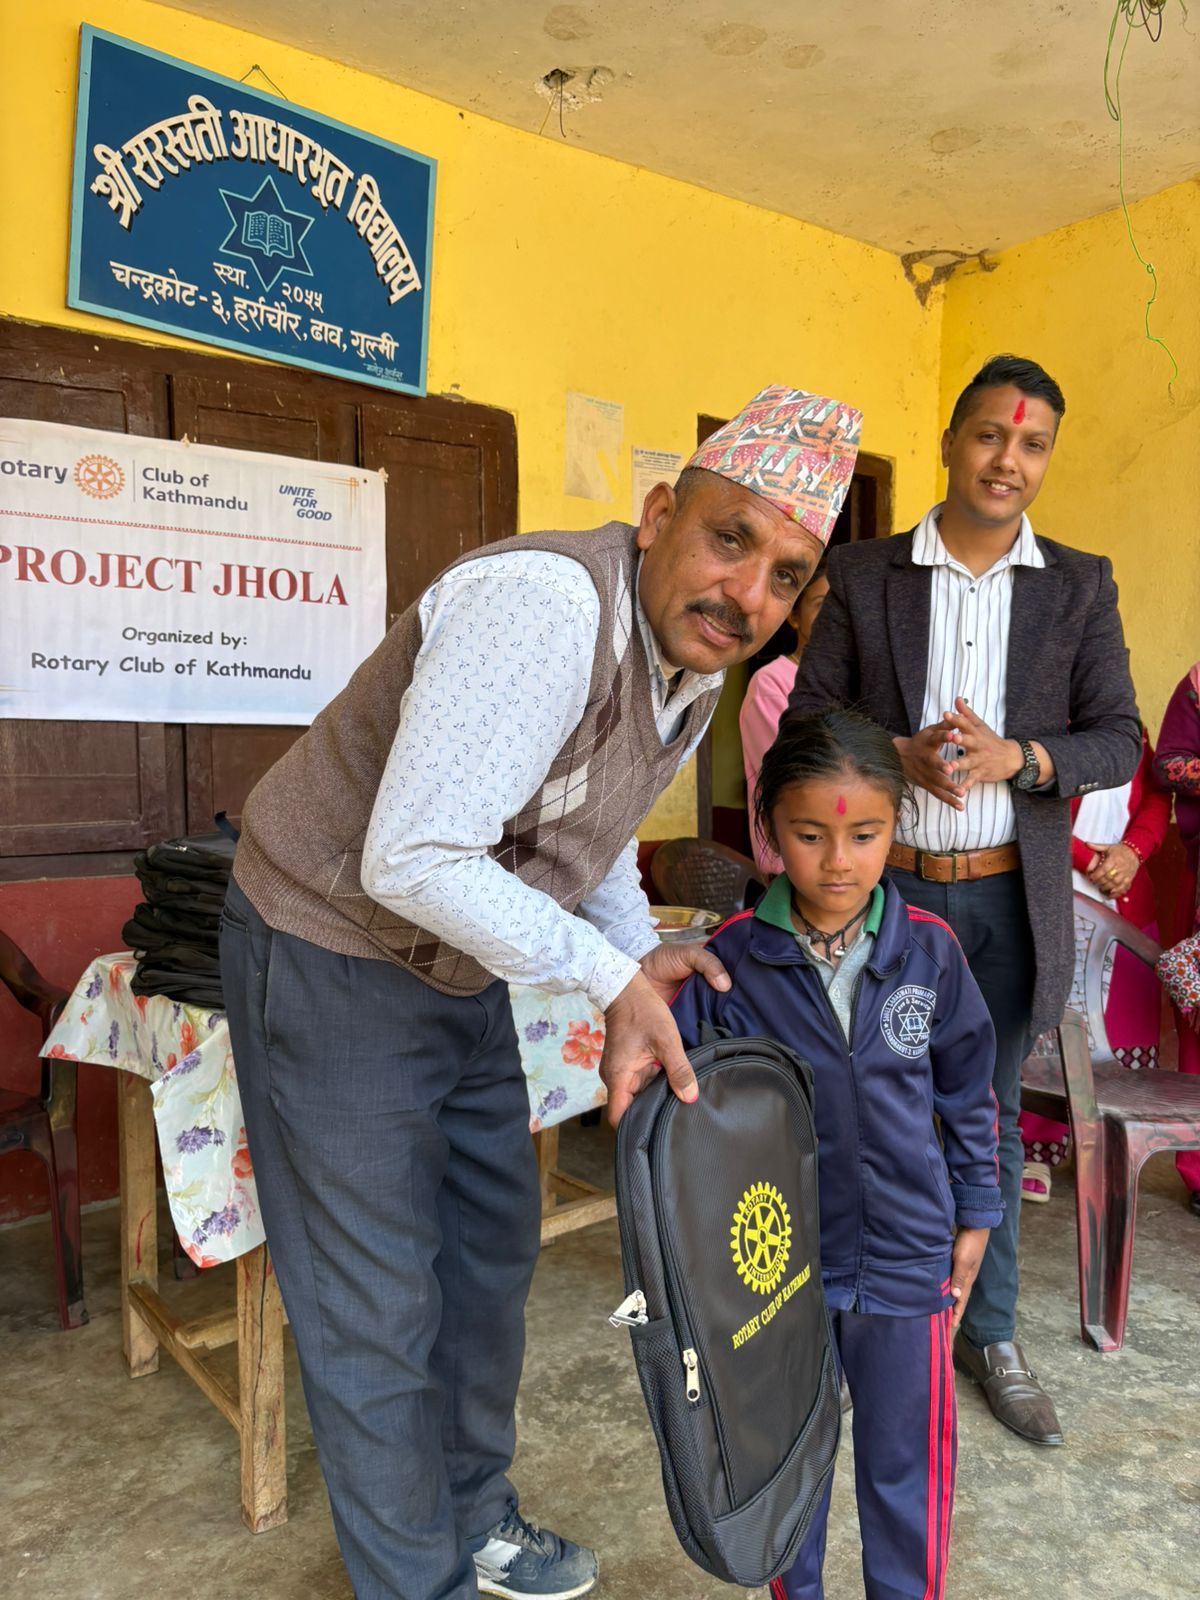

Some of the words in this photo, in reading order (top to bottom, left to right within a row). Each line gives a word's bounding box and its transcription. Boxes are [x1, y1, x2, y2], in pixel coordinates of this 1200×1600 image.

[91, 144, 142, 229] श्री
[122, 94, 229, 188] सरस्वती
[230, 110, 353, 207] आधारभूत
[347, 174, 422, 304] विद्यालय
[213, 262, 250, 289] स्था.
[282, 282, 323, 313] २०५५
[351, 331, 399, 361] गुल्मी
[0, 459, 67, 484] otary
[143, 467, 184, 485] Club
[190, 474, 209, 488] of
[143, 487, 248, 511] Kathmandu
[279, 485, 315, 498] UNITE
[292, 498, 317, 509] FOR
[296, 508, 332, 521] GOOD
[213, 563, 349, 606] JHOLA
[122, 627, 213, 645] Organized
[220, 632, 248, 646] by:
[31, 652, 109, 675] Rotary
[119, 656, 165, 673] Club
[175, 658, 197, 675] of
[206, 660, 312, 681] Kathmandu
[744, 1194, 768, 1215] ROTARY
[749, 1238, 786, 1283] INTERNATIONAL
[732, 1315, 761, 1350] ROTARY
[760, 1300, 776, 1325] CLUB
